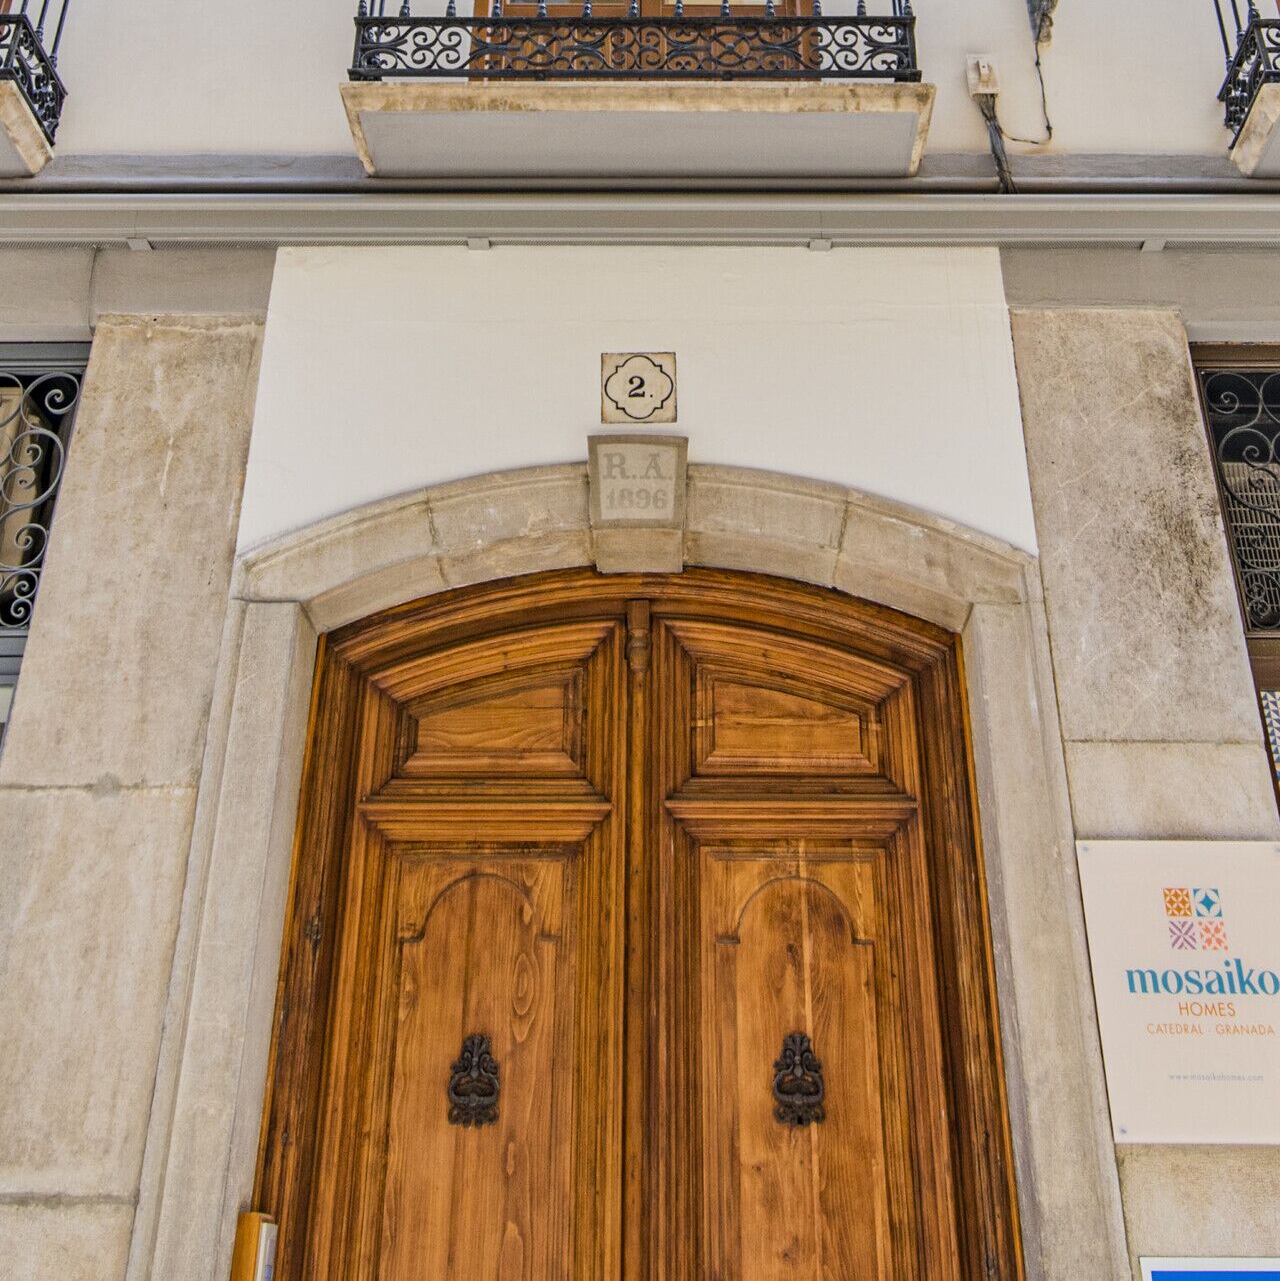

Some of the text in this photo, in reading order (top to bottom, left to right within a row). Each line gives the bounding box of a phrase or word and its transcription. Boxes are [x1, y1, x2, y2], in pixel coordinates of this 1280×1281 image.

[606, 488, 668, 511] 1896
[1125, 957, 1280, 996] mosaiko
[1177, 1001, 1237, 1018] HOMES
[1146, 1022, 1276, 1037] CATEDRAL GRANADA
